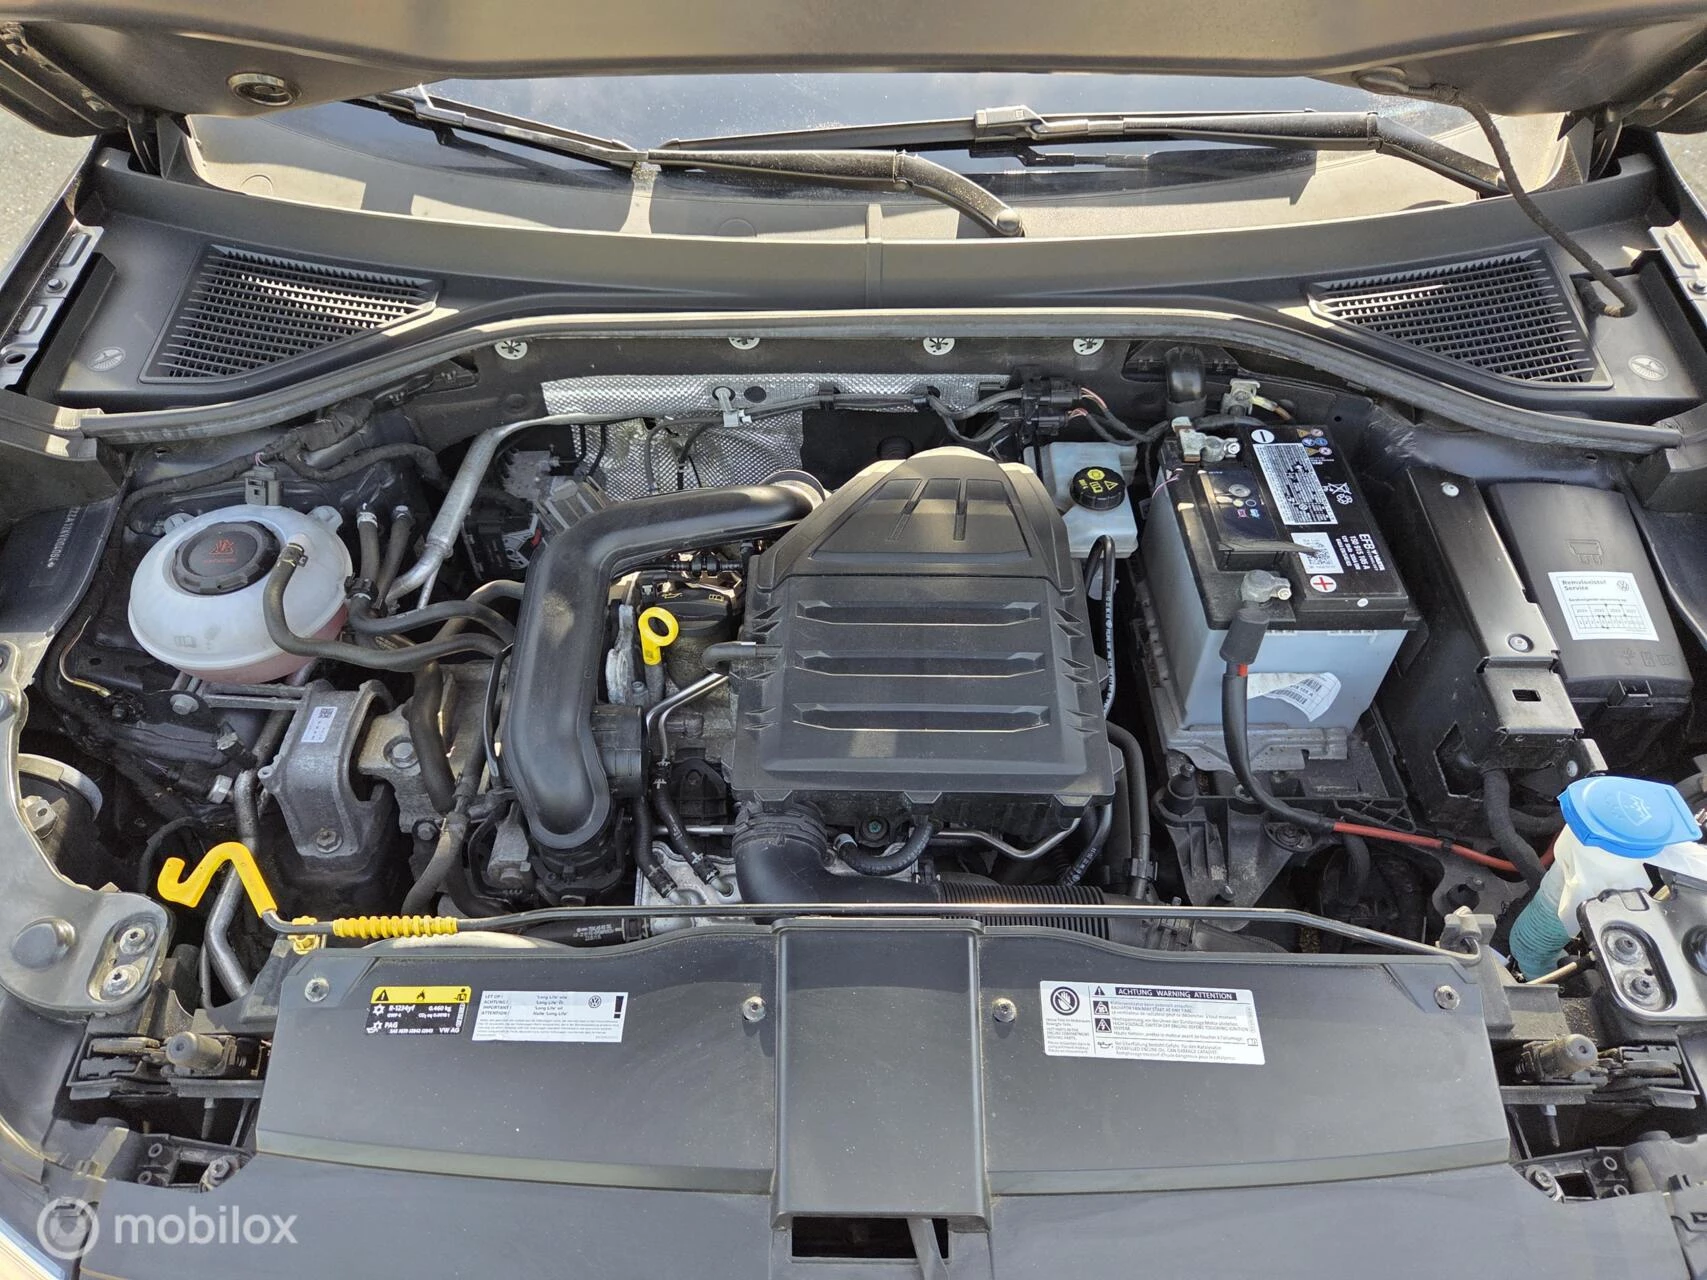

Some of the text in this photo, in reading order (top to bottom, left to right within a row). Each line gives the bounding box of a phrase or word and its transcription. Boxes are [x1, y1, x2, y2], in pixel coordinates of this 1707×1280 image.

[1359, 533, 1376, 550] EFB
[1118, 988, 1233, 1000] ACHTUNG WARNING ATTENTION
[384, 1021, 399, 1029] PAG
